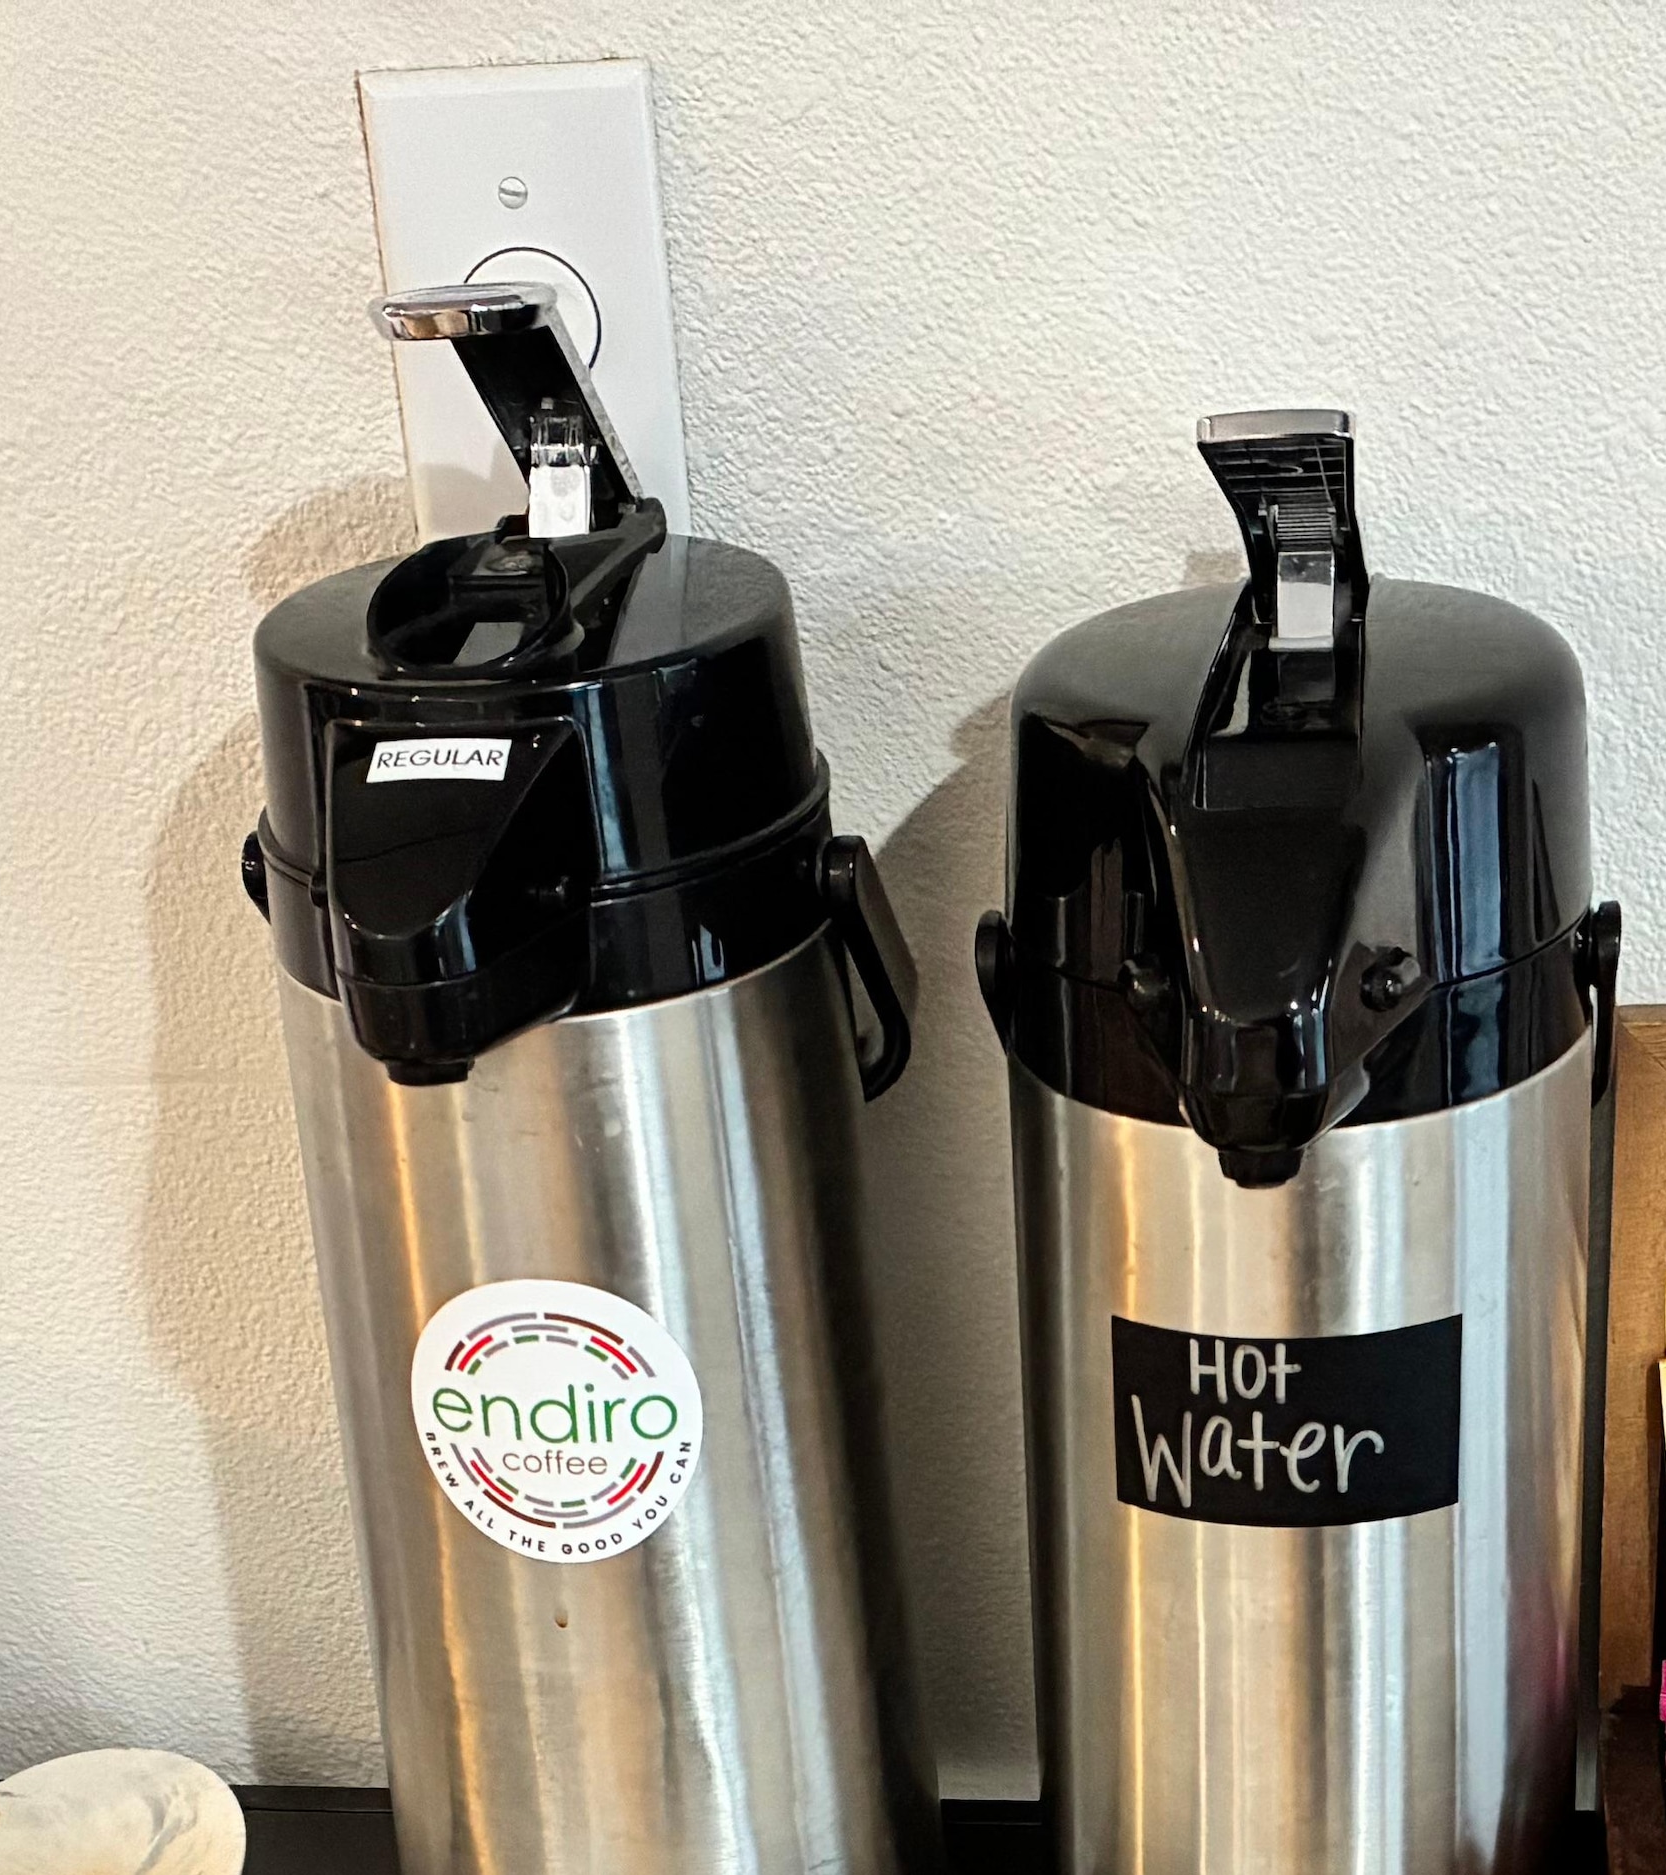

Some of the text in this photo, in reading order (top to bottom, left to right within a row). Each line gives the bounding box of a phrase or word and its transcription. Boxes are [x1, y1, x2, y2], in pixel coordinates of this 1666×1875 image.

[376, 749, 504, 769] REGULAR
[432, 1383, 678, 1444] endiro
[502, 1449, 608, 1475] coffee
[1131, 1394, 1385, 1508] Water
[464, 1498, 494, 1530] ALL
[508, 1530, 546, 1553] THE
[562, 1533, 623, 1555] GOOD
[632, 1495, 668, 1530] YOU
[669, 1441, 692, 1485] CAN
